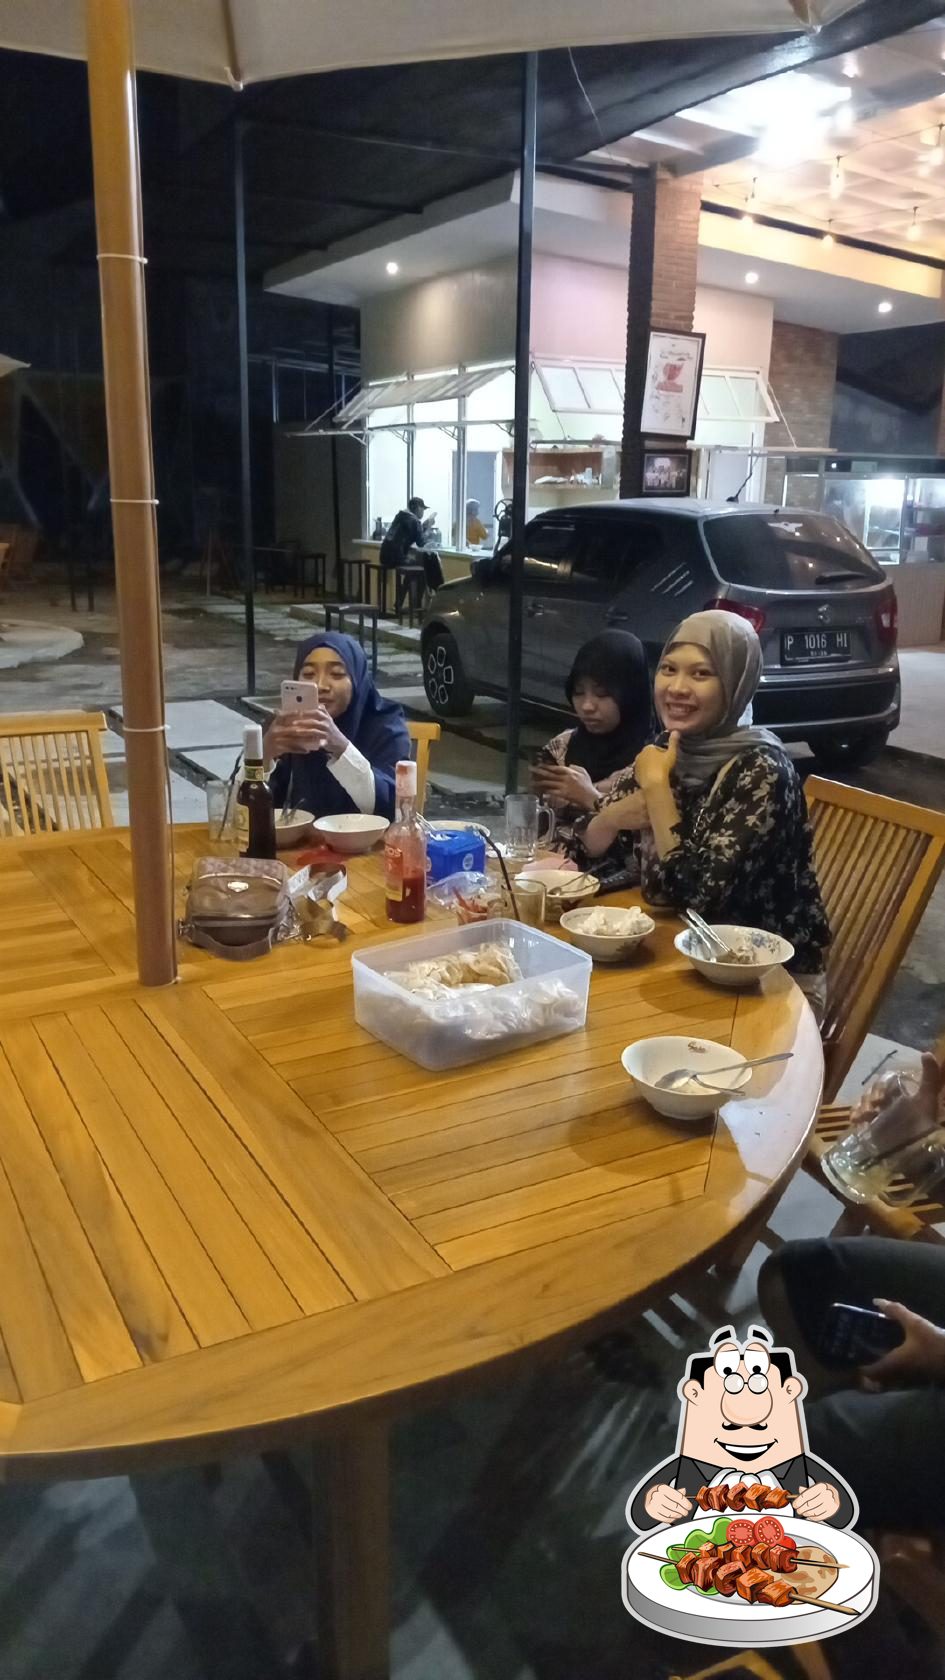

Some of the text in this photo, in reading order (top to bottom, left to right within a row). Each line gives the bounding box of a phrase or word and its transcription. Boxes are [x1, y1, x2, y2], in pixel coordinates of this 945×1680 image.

[787, 632, 848, 650] P 1016 HI
